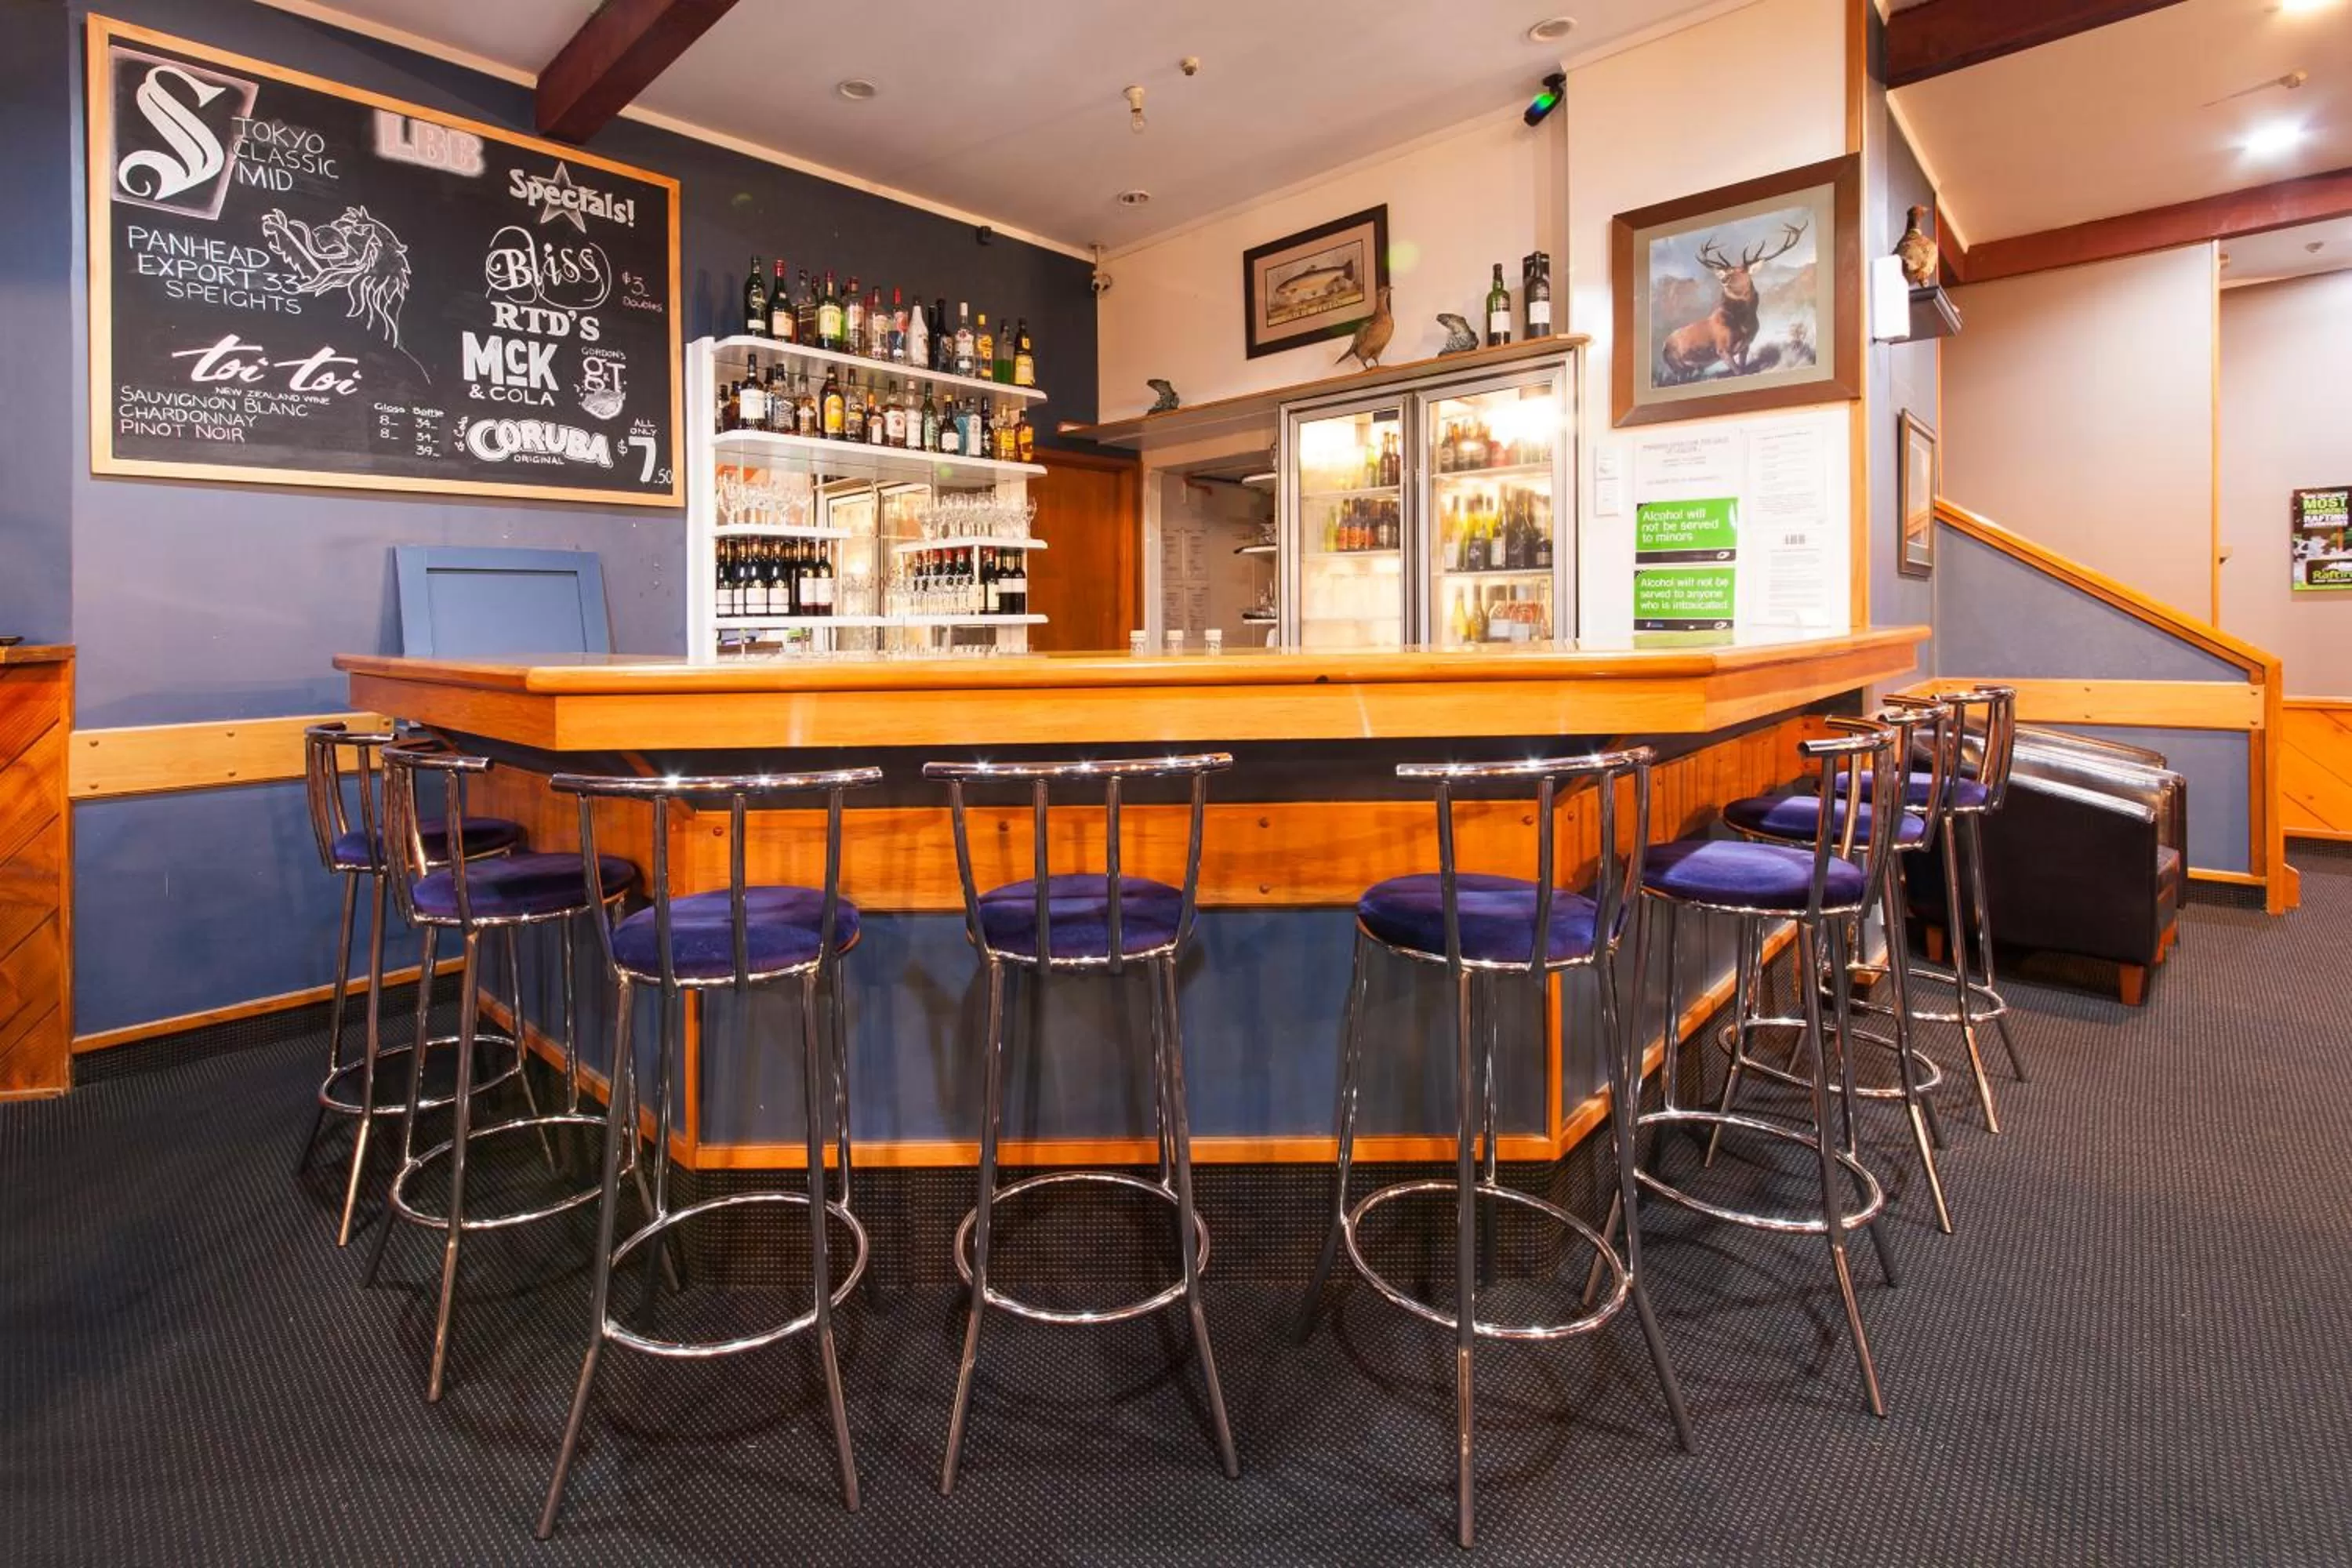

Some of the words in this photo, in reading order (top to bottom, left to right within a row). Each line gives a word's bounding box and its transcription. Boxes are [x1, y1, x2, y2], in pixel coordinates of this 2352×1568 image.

[232, 116, 325, 154] TOKYO
[234, 140, 339, 180] CLASSIC
[238, 163, 293, 191] MID
[509, 168, 635, 228] Specials!
[128, 225, 270, 269] PANHEAD
[137, 252, 257, 289] EXPORT
[263, 273, 303, 296] 33
[485, 226, 612, 310] Bliss
[165, 280, 302, 315] SPEIGHTS
[172, 333, 269, 382] toi
[274, 346, 362, 395] toi
[120, 385, 236, 412] SAUVIGNON
[245, 397, 308, 416] BLANC
[216, 387, 242, 397] NEW
[247, 390, 300, 402] ZEALAND
[303, 394, 331, 405] WINE
[469, 383, 485, 400] &
[490, 387, 555, 407] COLA
[119, 404, 257, 427] CHARDONNAY
[634, 418, 655, 427] ALL
[120, 419, 186, 438] PINOT
[195, 424, 245, 443] NOIR
[630, 427, 657, 437] ONLY
[466, 418, 613, 469] CORUBA
[514, 454, 565, 465] ORIGINAL
[1642, 510, 1683, 522] Alcohol
[1686, 508, 1707, 520] will
[2303, 496, 2346, 510] MOST
[1642, 522, 1659, 532] not
[1663, 521, 1677, 532] be
[1680, 518, 1719, 531] served
[1642, 533, 1653, 543] to
[1656, 531, 1693, 543] minors
[1641, 576, 1674, 587] Alcohol
[1677, 577, 1694, 586] will
[1697, 578, 1713, 586] not
[1639, 601, 1660, 611] who
[1640, 590, 1671, 599] served
[1674, 590, 1685, 598] to
